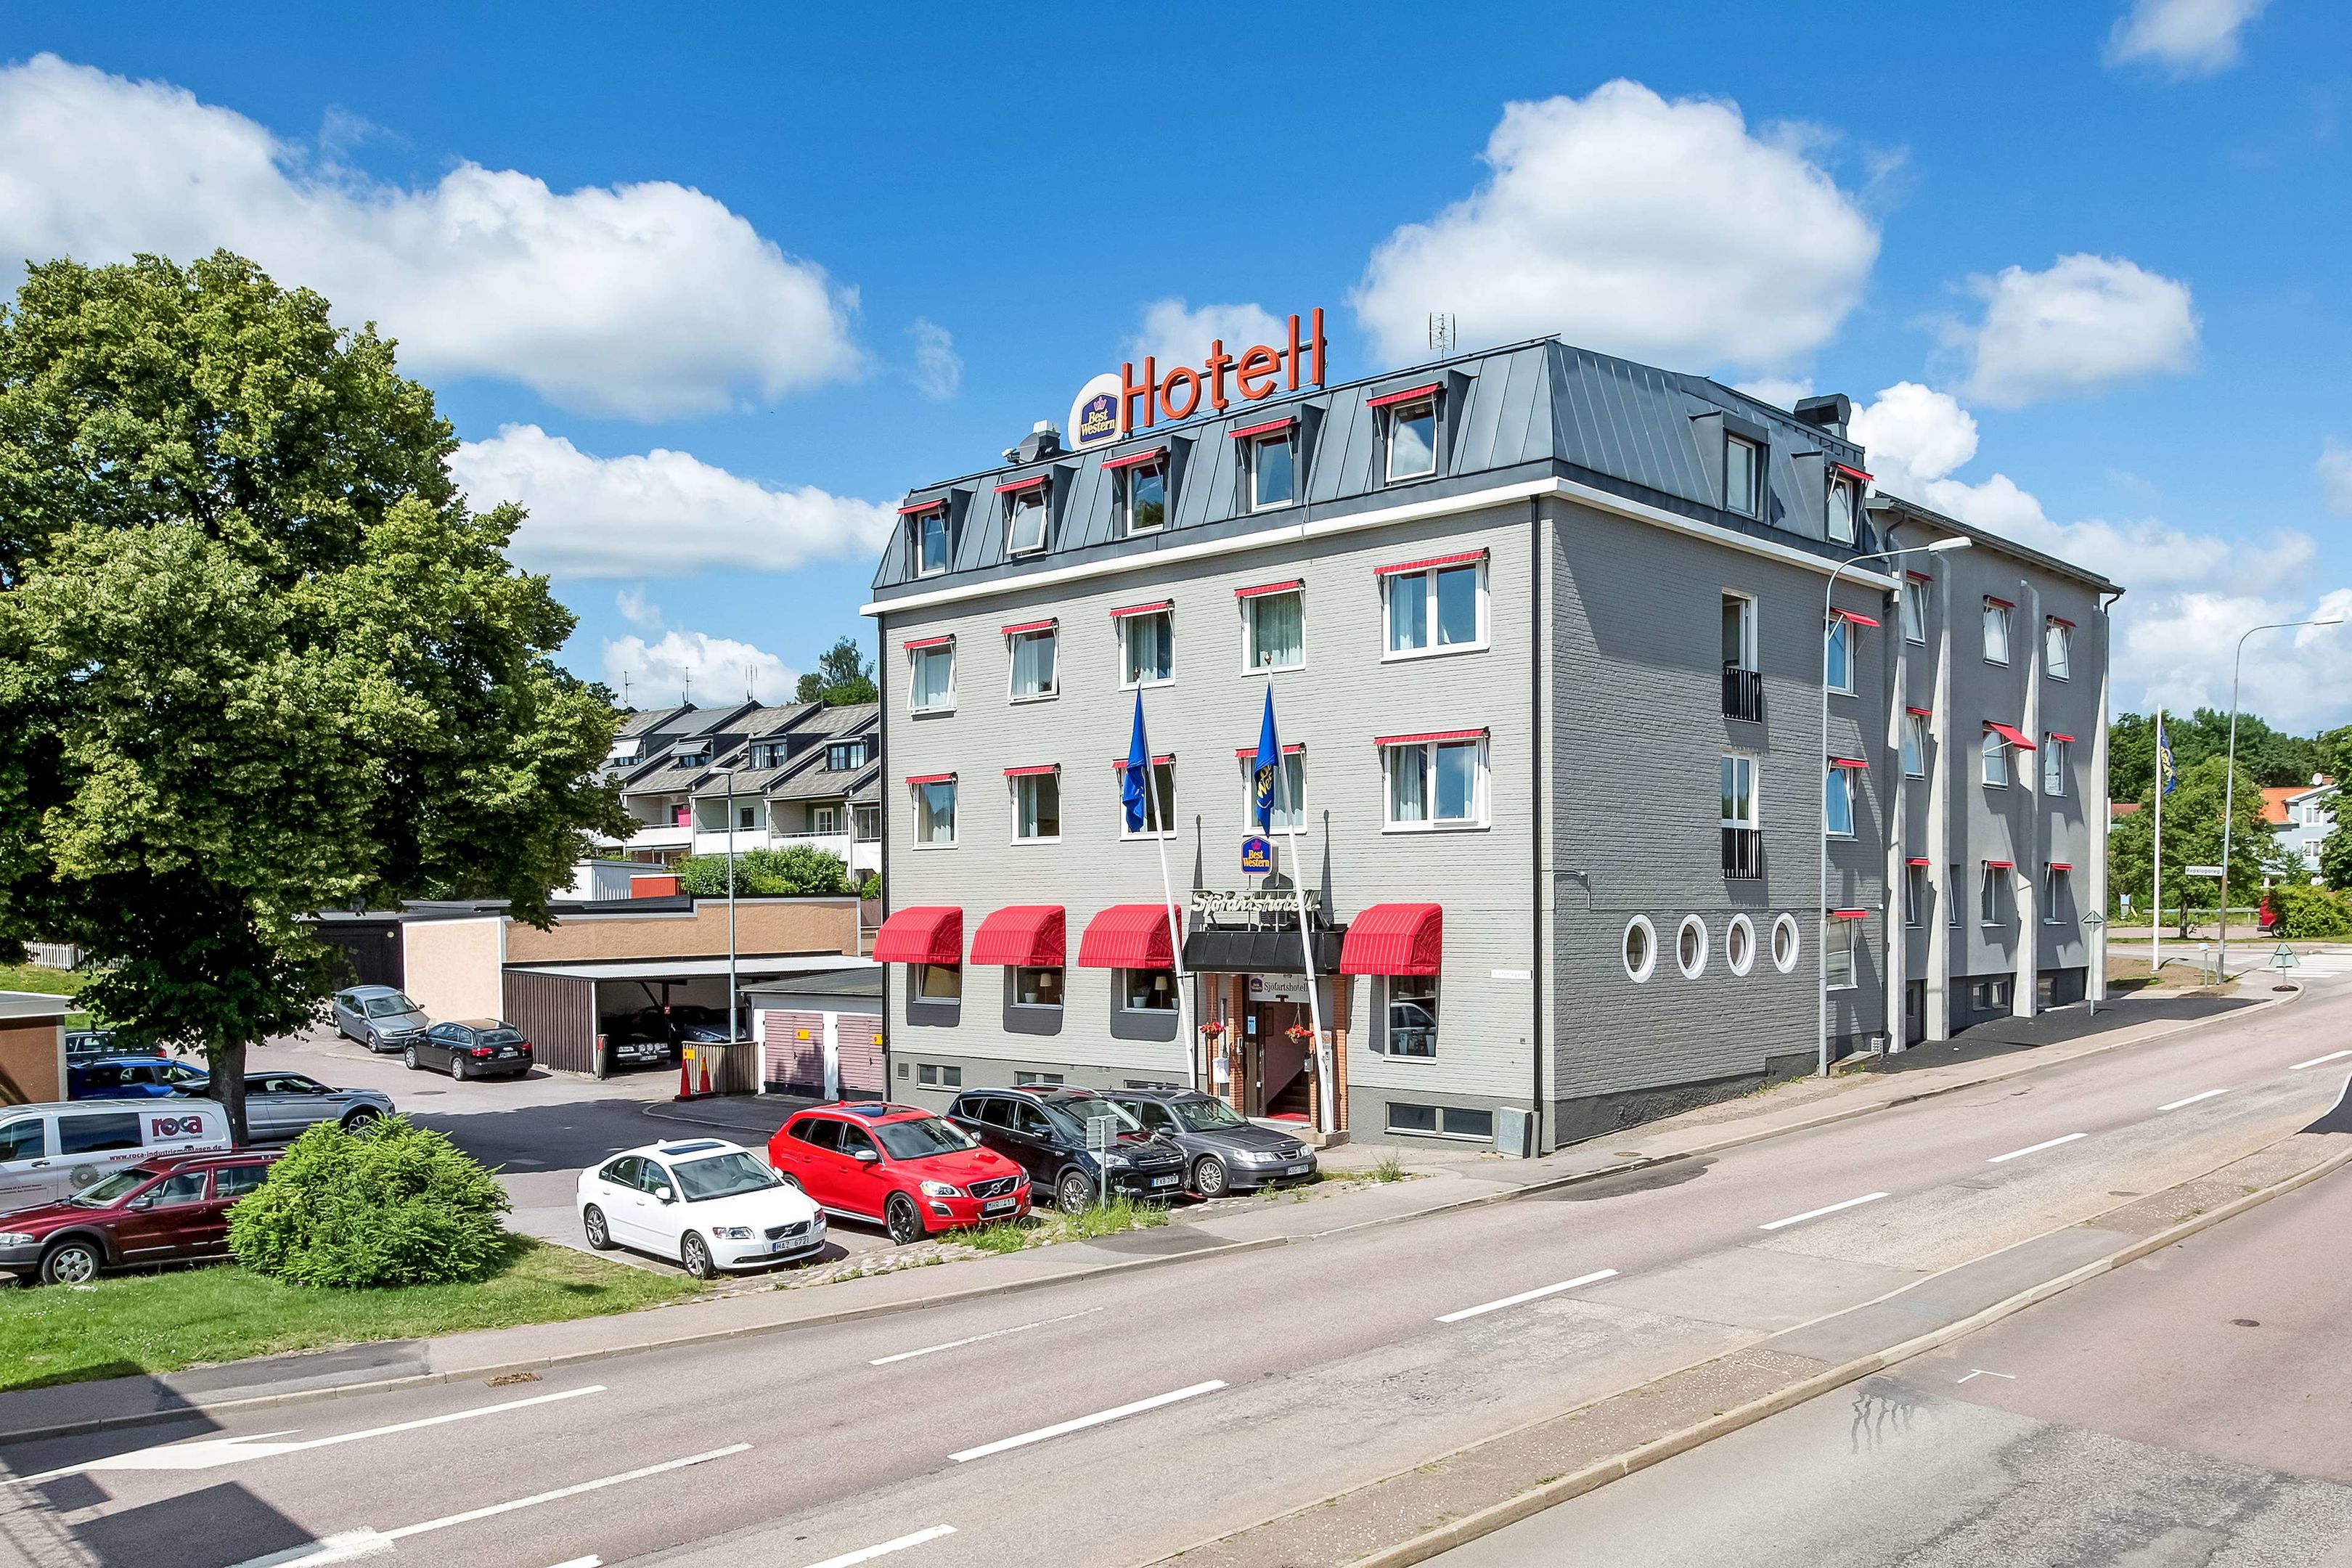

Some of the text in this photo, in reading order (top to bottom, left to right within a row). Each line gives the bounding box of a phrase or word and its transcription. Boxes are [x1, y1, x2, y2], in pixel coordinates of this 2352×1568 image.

[1122, 307, 1324, 433] Hotell
[1089, 408, 1108, 425] Best
[1081, 419, 1115, 436] Western
[1243, 857, 1270, 867] Western
[1249, 849, 1263, 859] Best
[152, 1116, 203, 1137] roca
